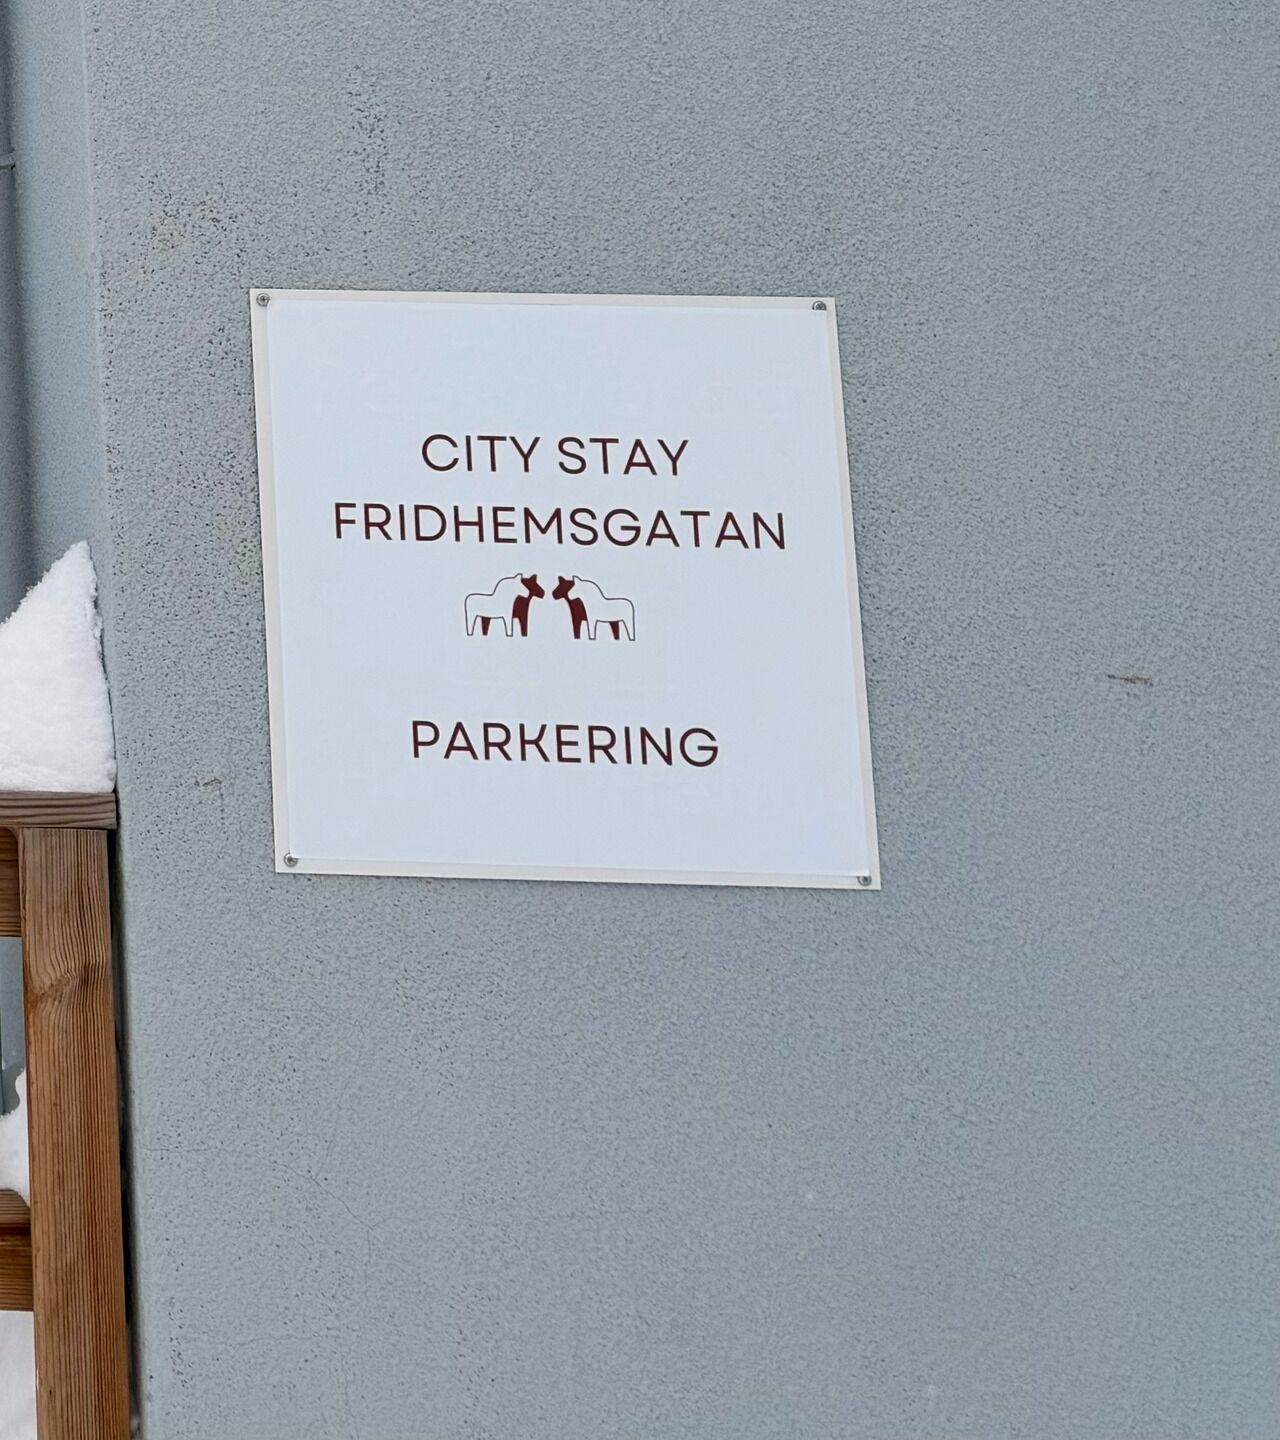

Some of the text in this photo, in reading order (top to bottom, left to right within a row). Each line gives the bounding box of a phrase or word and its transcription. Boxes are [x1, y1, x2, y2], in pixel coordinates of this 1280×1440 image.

[421, 433, 689, 477] CITY STAY
[334, 502, 786, 550] FRIDHEMSGATAN
[412, 719, 719, 768] PARKERING
